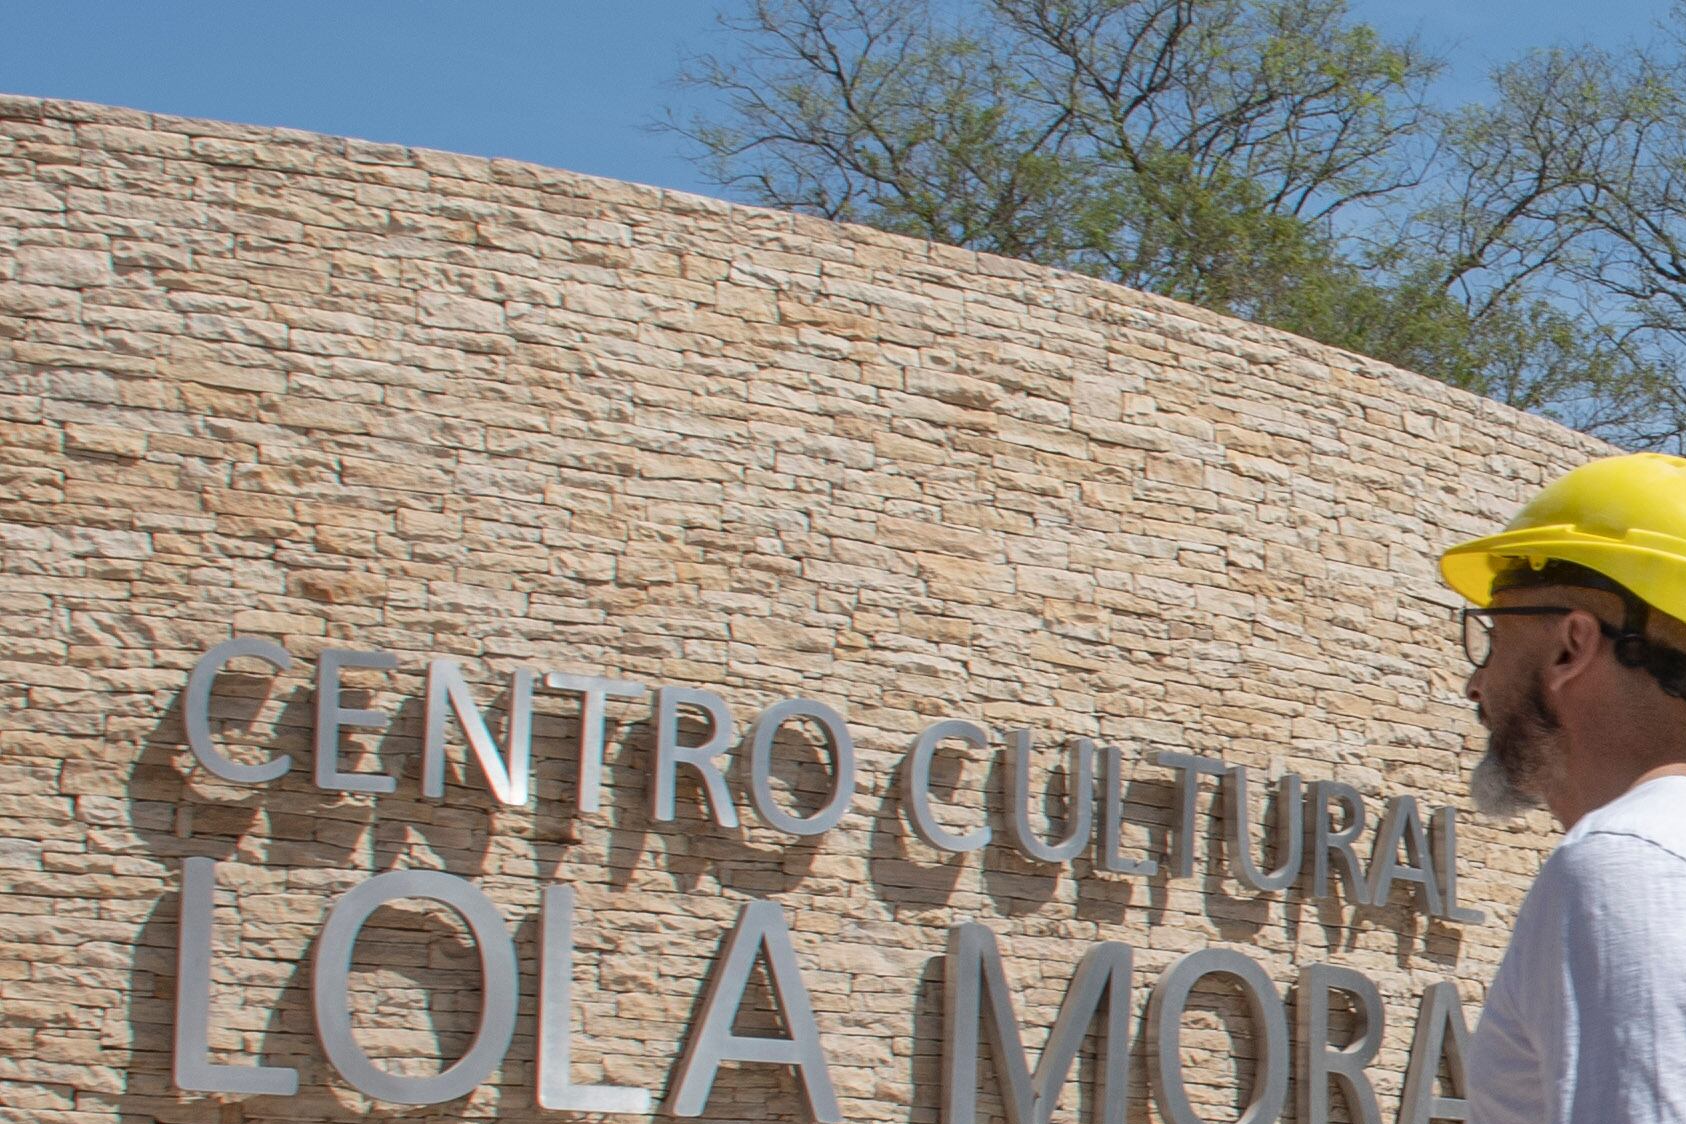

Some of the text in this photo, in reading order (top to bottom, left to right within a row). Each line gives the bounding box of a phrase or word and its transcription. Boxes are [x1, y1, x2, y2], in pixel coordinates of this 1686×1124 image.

[183, 637, 1486, 924] CENTRO CULTURAL
[174, 856, 842, 1124] LOLA
